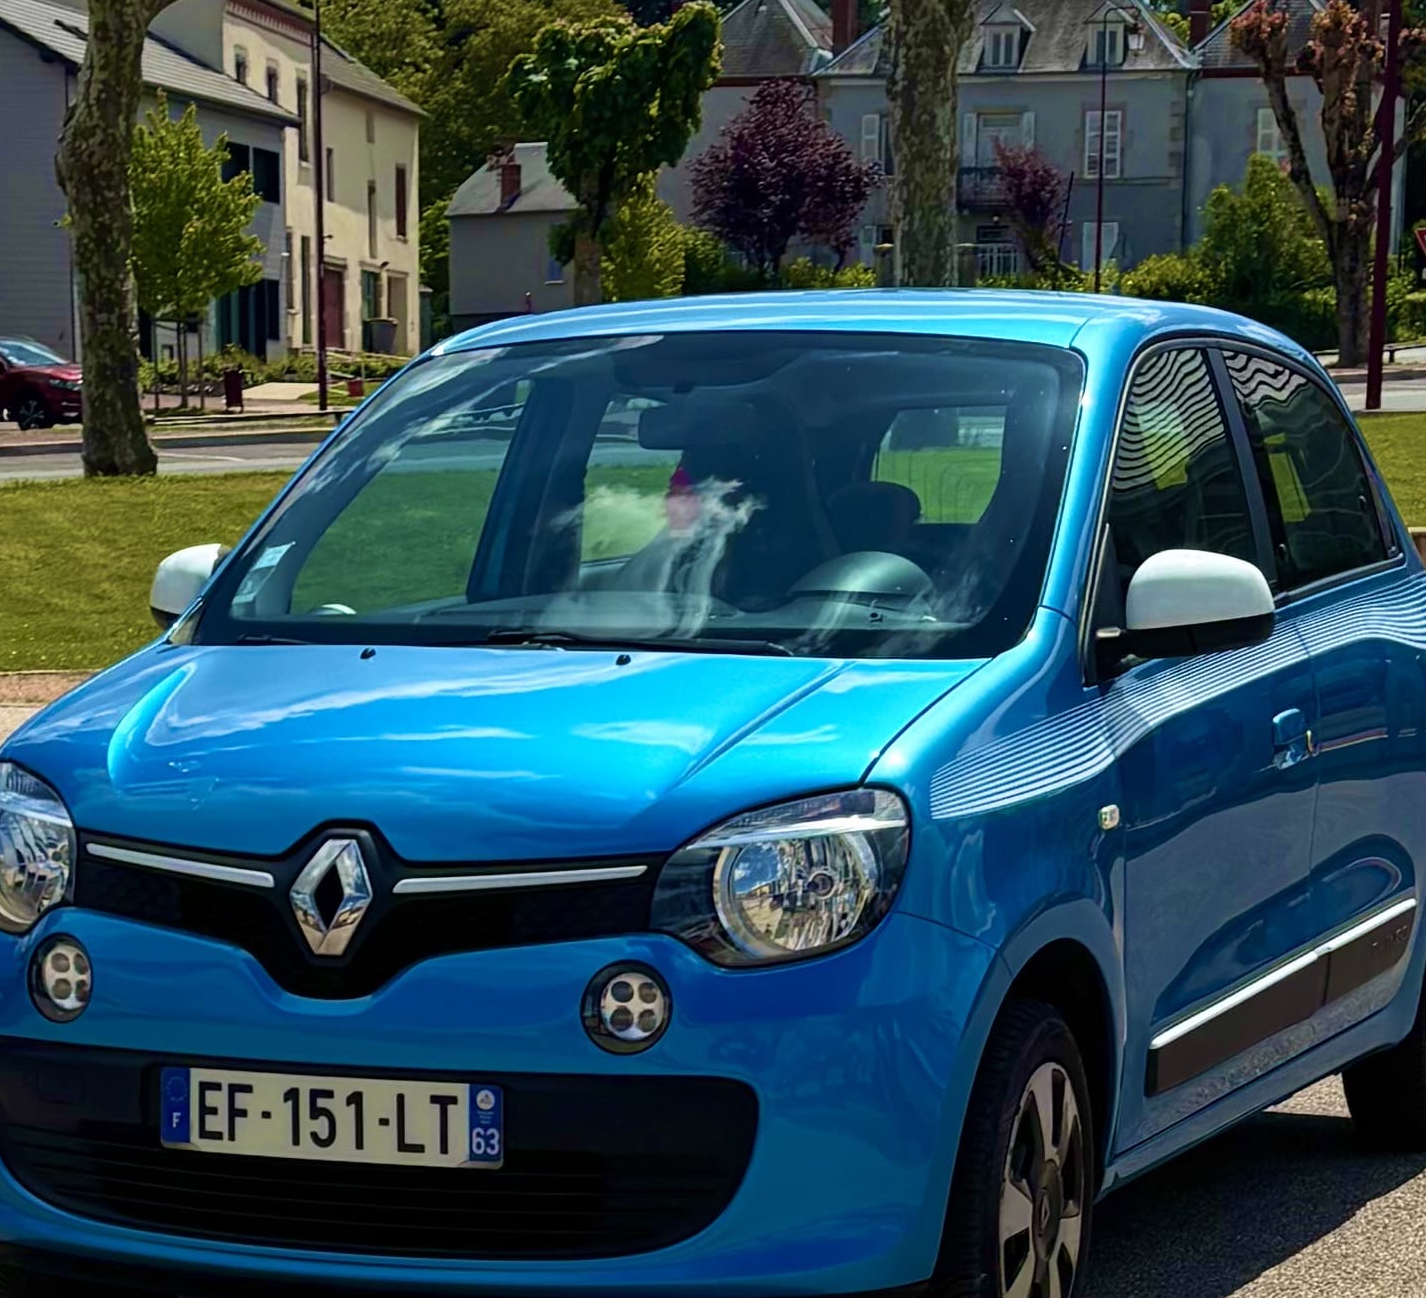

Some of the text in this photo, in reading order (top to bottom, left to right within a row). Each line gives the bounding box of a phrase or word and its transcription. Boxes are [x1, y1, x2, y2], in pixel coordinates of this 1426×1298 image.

[172, 1111, 182, 1128] F
[198, 1080, 459, 1155] EF-151-LT
[472, 1127, 500, 1156] 63
